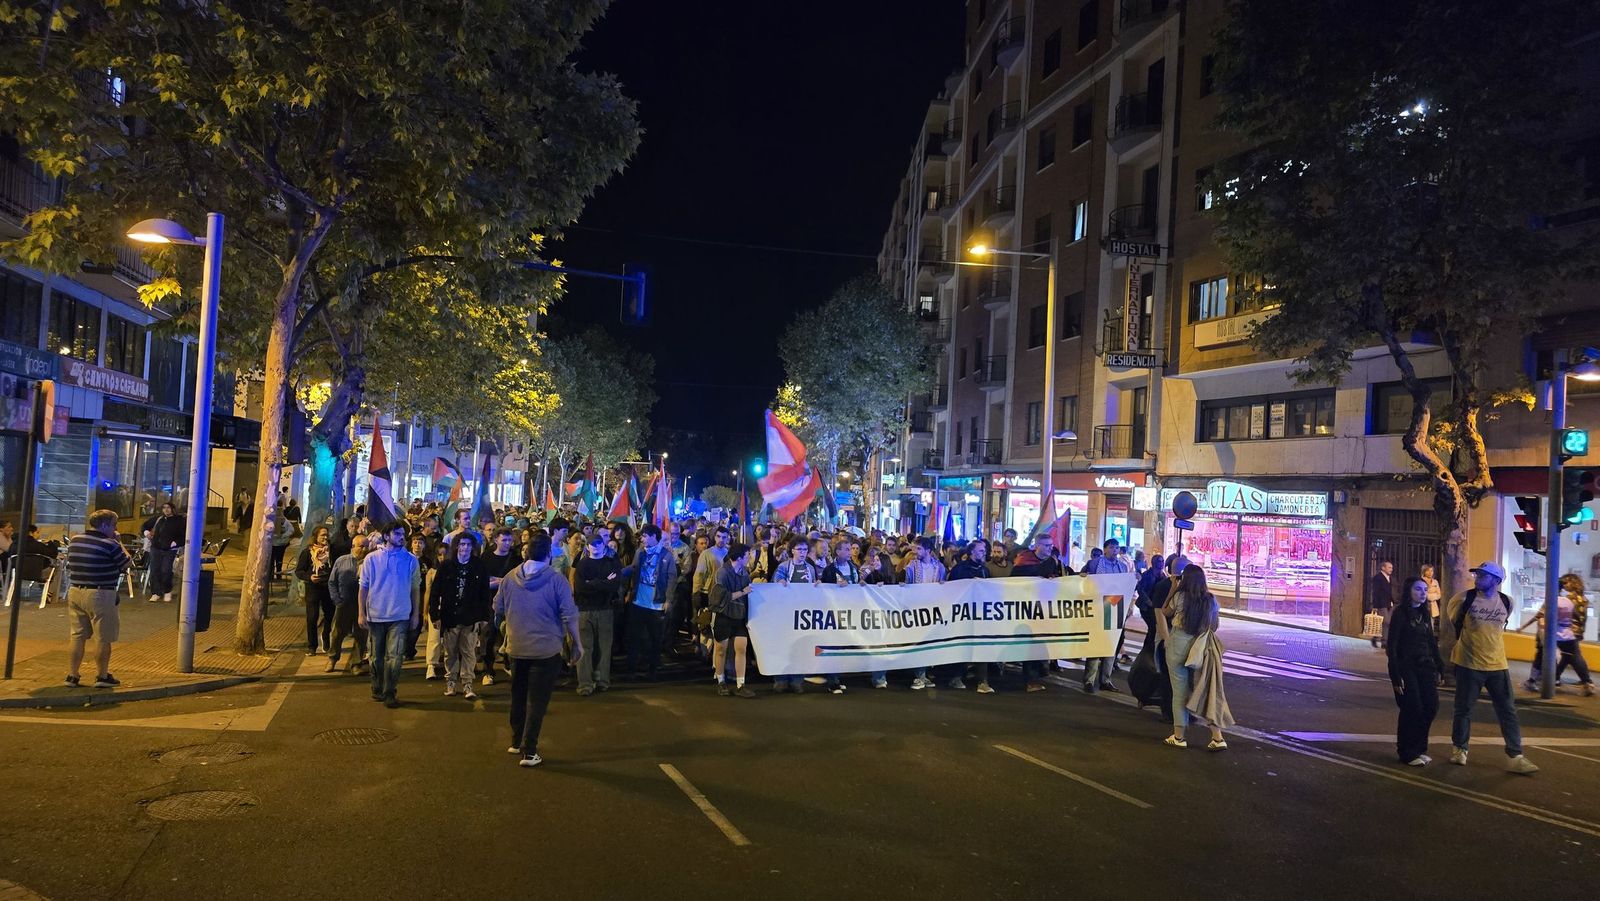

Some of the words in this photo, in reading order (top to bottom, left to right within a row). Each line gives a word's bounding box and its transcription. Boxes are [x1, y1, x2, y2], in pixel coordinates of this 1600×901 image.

[1112, 242, 1157, 256] HOSTAL
[1128, 257, 1140, 352] INTERNACIONAL
[1106, 354, 1156, 368] RESIDENCIA
[1270, 495, 1326, 506] CHARCUTERIA
[1274, 504, 1320, 514] JAMONERIA
[793, 608, 856, 631] ISRAEL
[860, 606, 948, 631] GENOCIDA,
[951, 600, 1044, 623] PALESTINA
[1048, 599, 1094, 619] LIBRE
